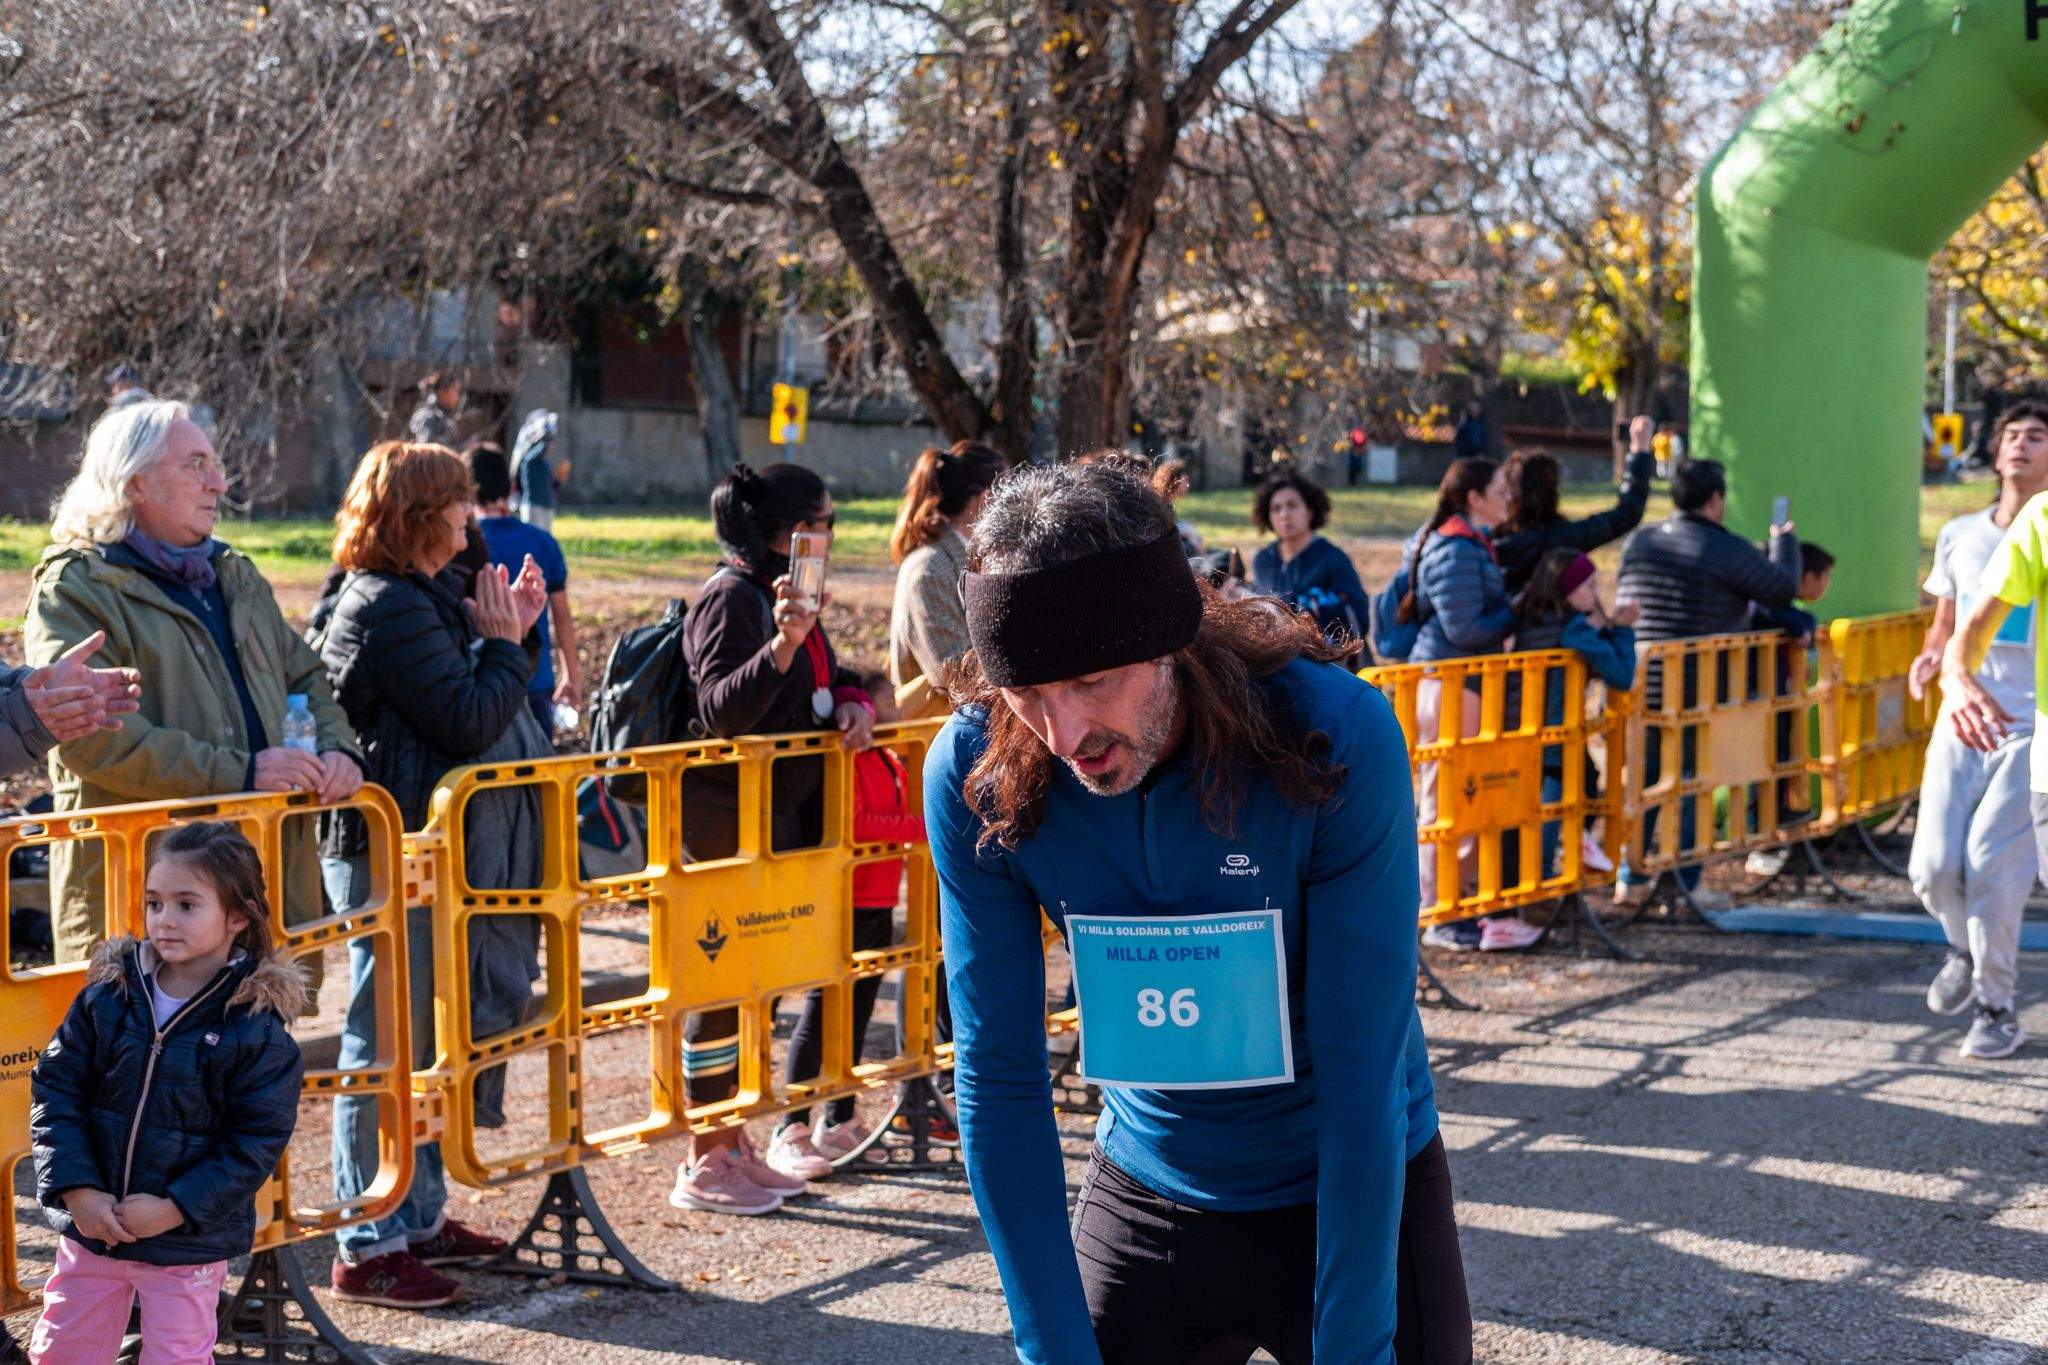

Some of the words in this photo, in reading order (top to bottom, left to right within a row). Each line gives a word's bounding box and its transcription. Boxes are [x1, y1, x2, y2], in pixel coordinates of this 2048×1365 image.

[1220, 865, 1260, 876] Kalenji
[1077, 924, 1087, 934] VI
[1088, 925, 1114, 935] MILLA
[1116, 924, 1171, 936] SOLIDÀRIA
[1174, 926, 1189, 936] DE
[1193, 920, 1266, 935] VALLDOREIX
[1106, 946, 1158, 962] MILLA
[1165, 945, 1221, 962] OPEN
[1136, 988, 1200, 1027] 86
[0, 1046, 40, 1067] oreix
